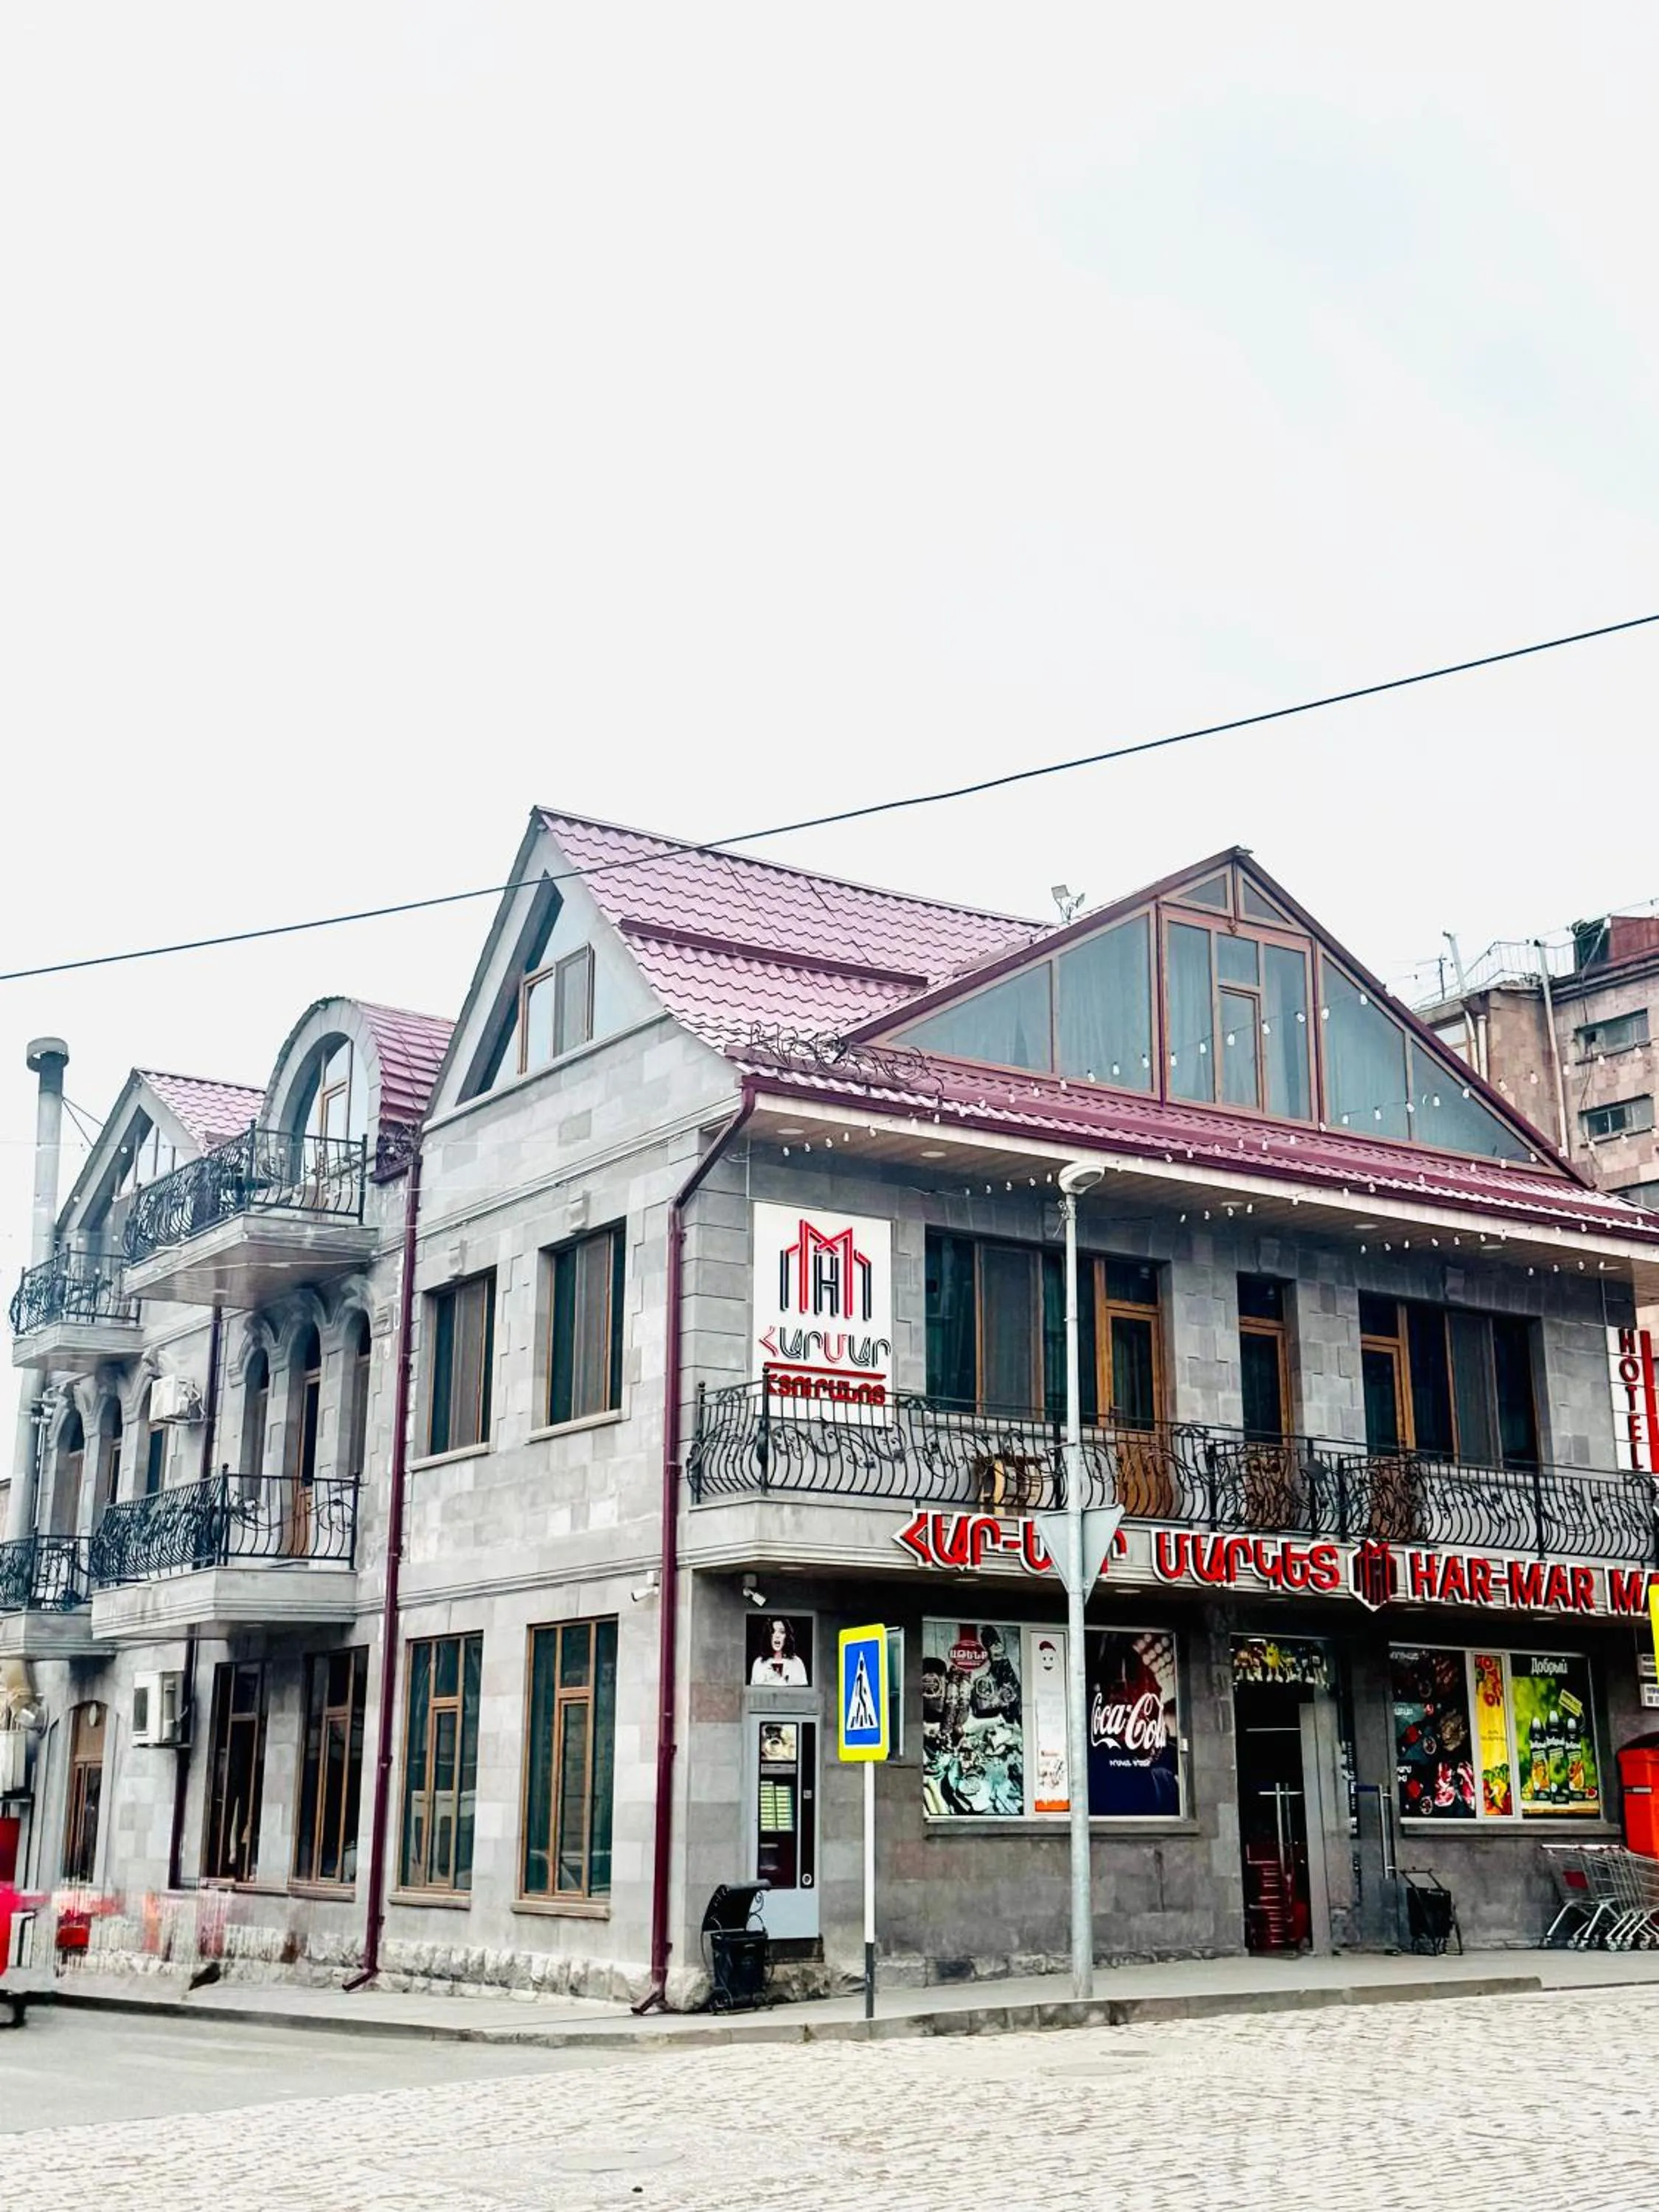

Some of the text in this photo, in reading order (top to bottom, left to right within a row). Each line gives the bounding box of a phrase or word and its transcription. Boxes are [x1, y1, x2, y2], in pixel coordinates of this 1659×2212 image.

[1618, 1328, 1644, 1470] HOTEL
[1152, 1529, 1341, 1593] ՄԱՐԿԵՏ
[1405, 1548, 1659, 1616] HAR-MAR M
[1531, 1657, 1568, 1676] Добрый
